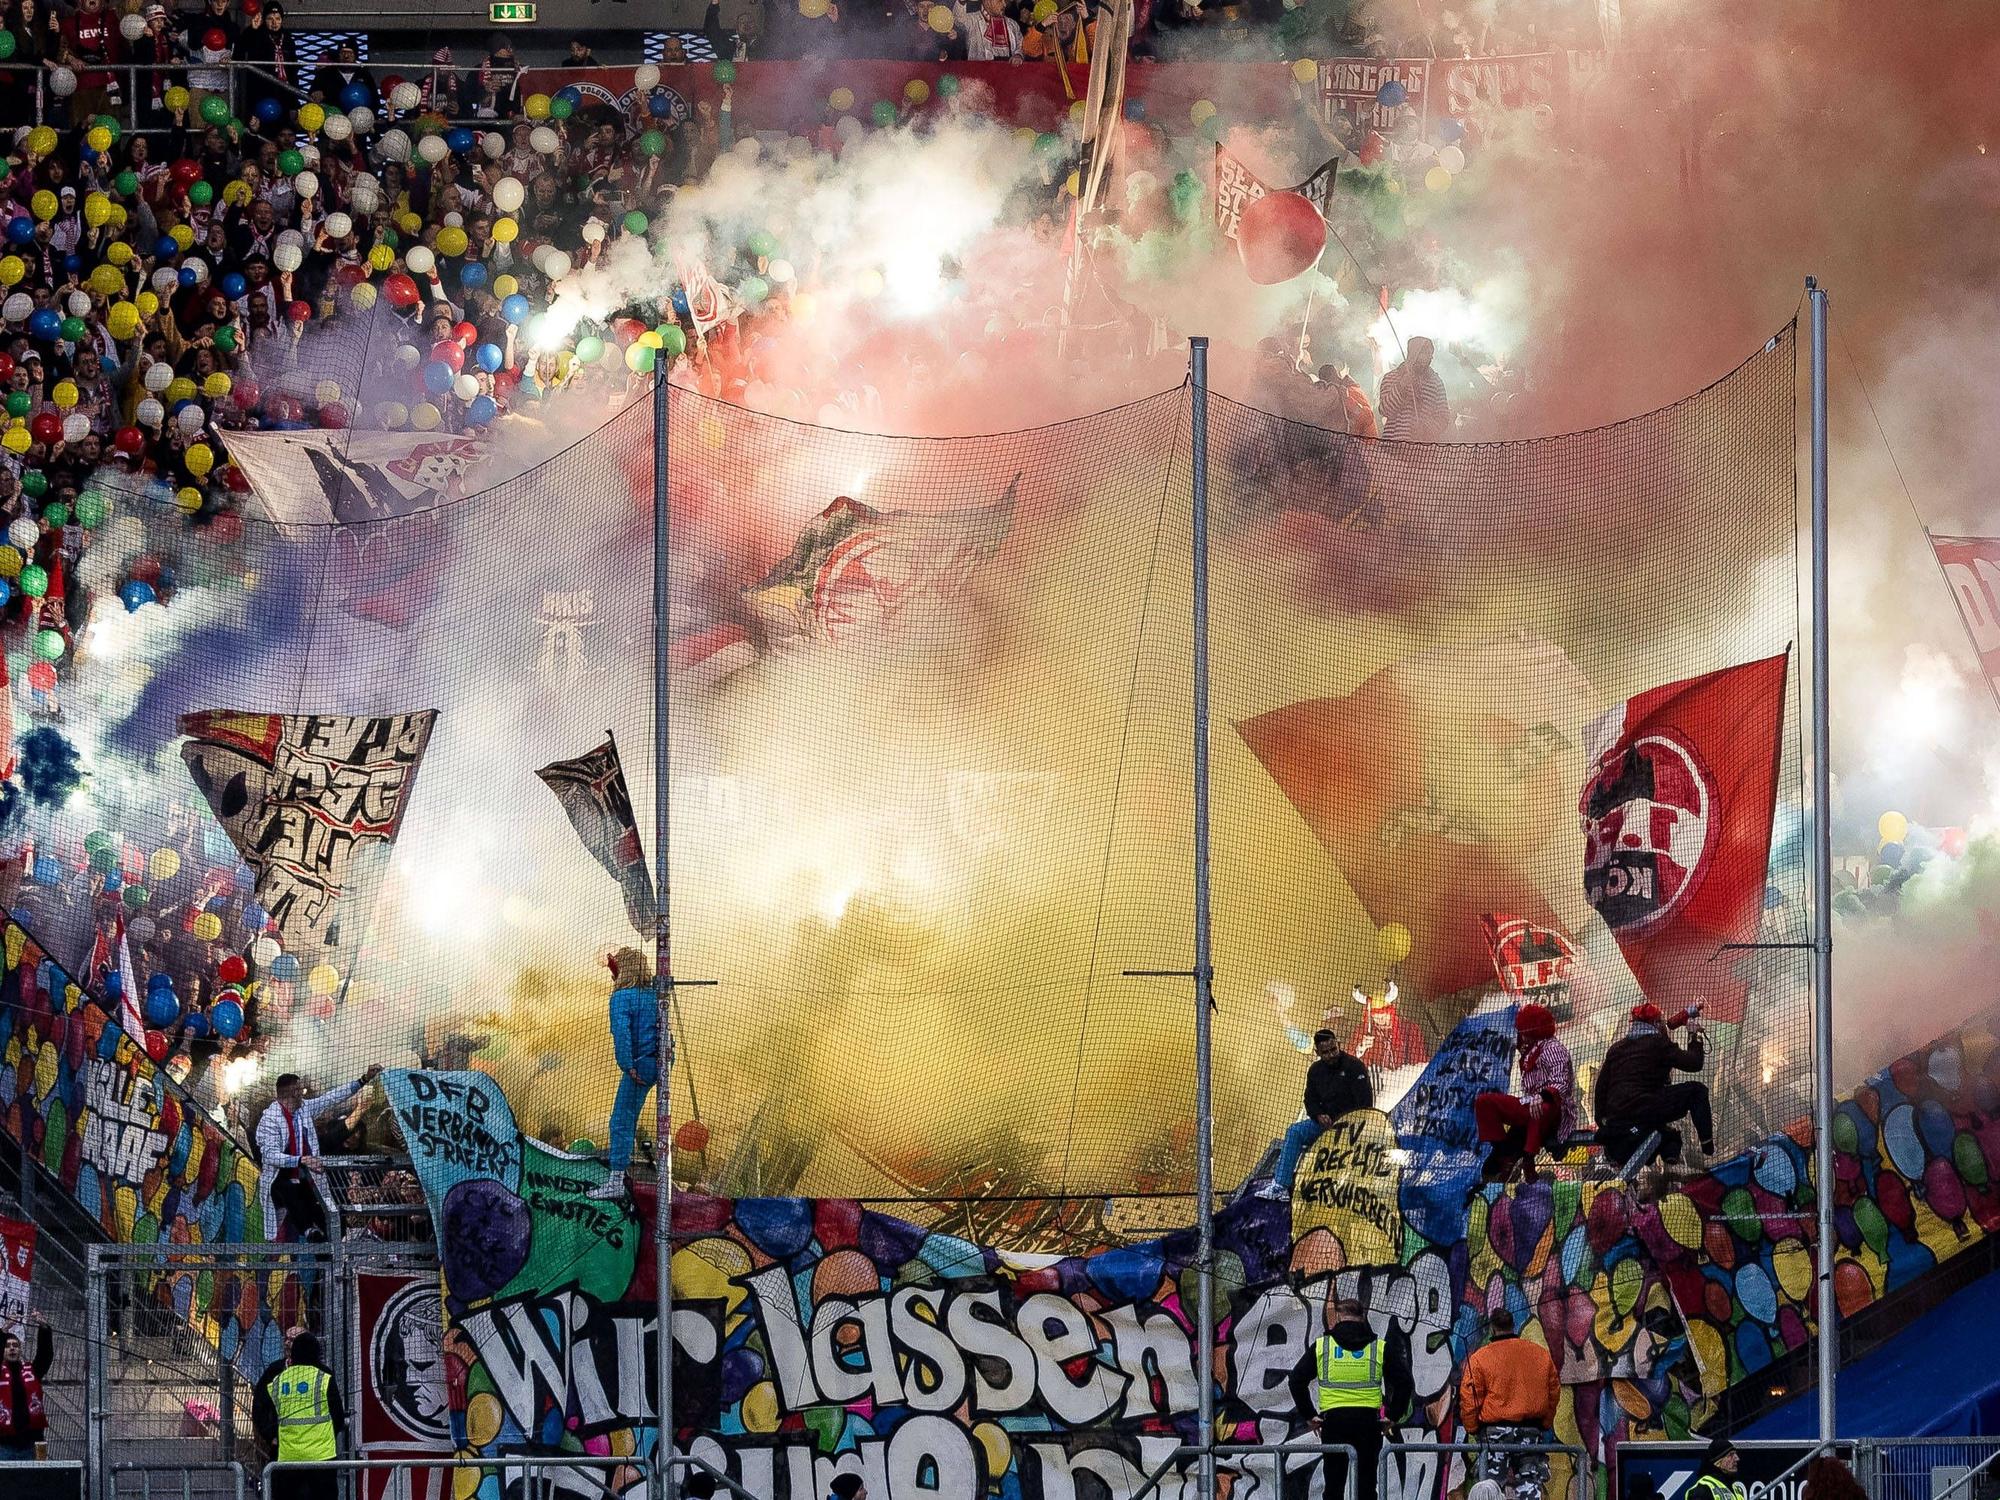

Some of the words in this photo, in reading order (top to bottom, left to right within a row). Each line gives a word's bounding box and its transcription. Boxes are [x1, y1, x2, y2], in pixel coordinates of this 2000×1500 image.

[408, 1073, 490, 1124] DFB
[418, 1132, 506, 1180] STRAFEN
[1332, 1120, 1367, 1146] TV
[459, 1291, 718, 1439] Wir
[745, 1264, 1199, 1424] lassen
